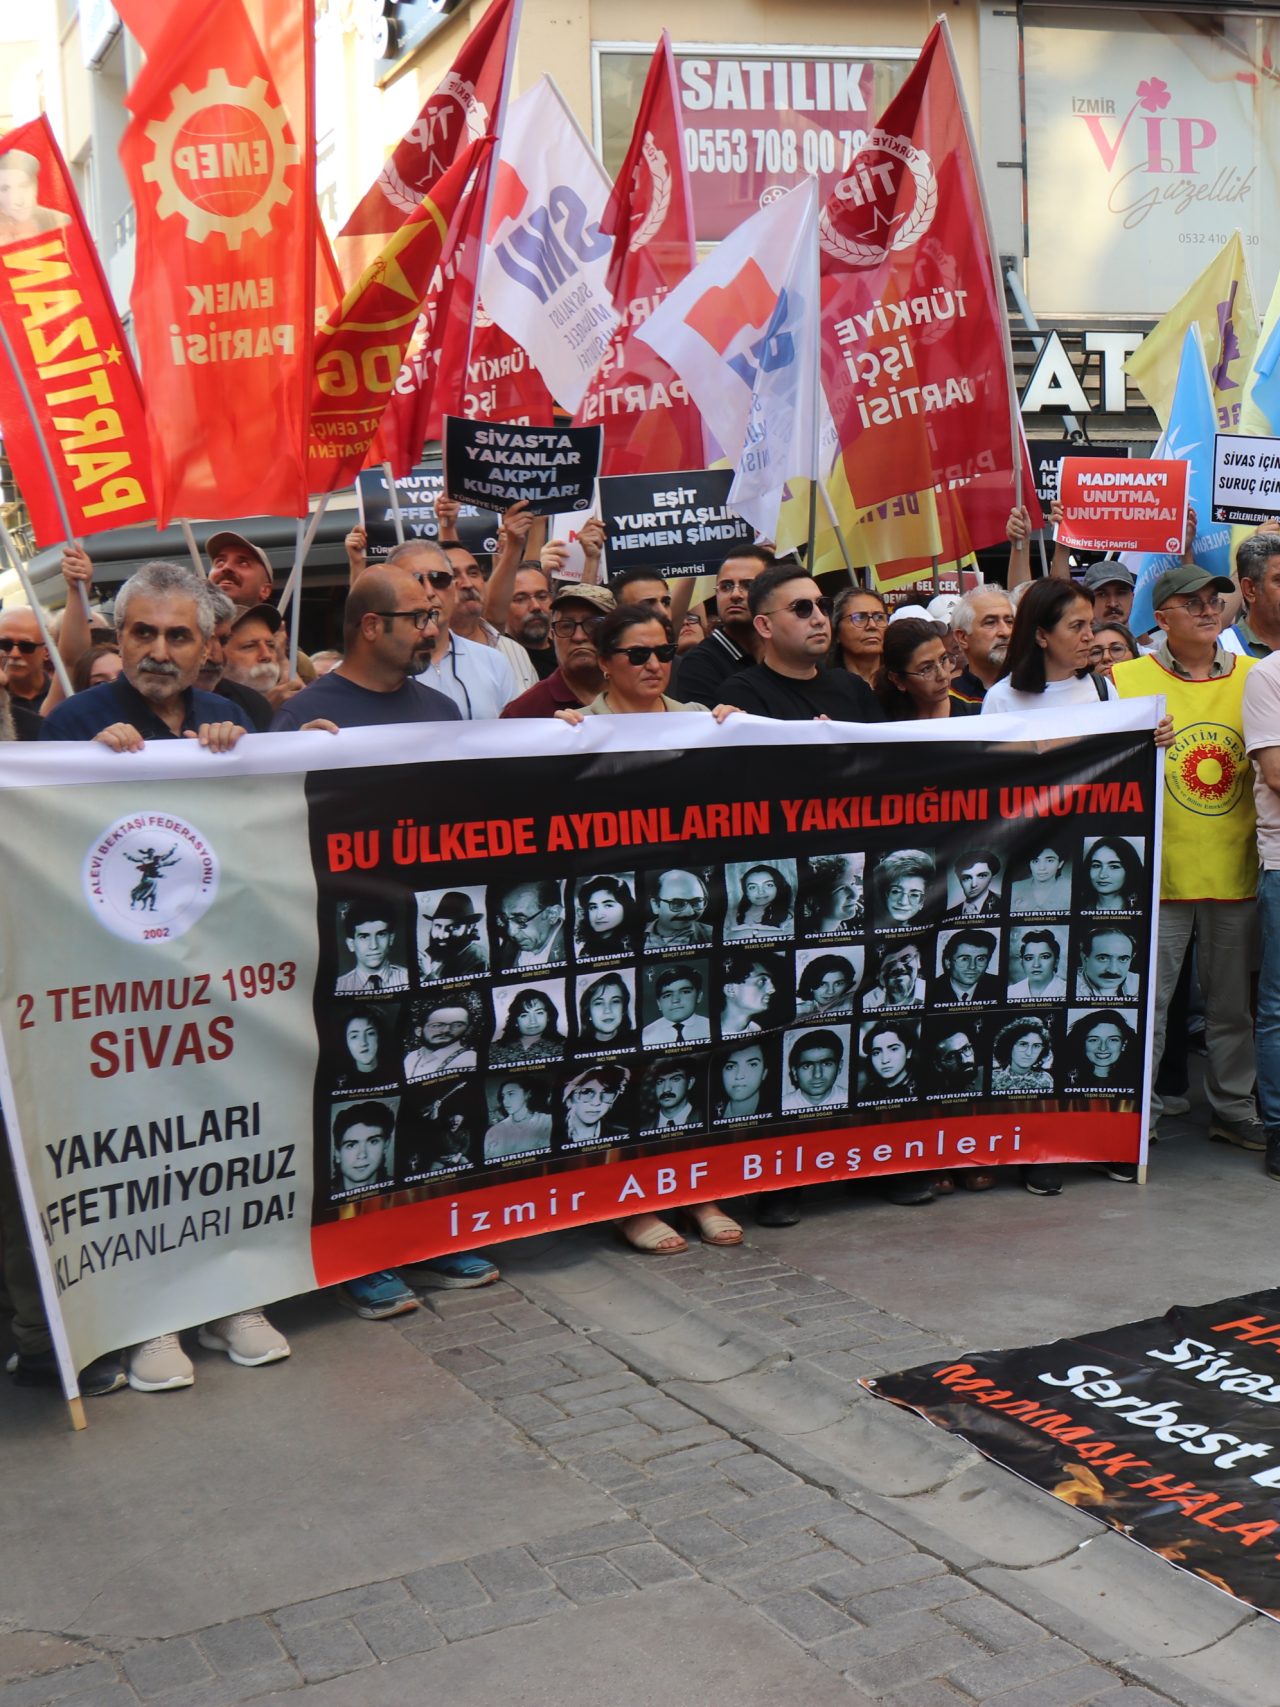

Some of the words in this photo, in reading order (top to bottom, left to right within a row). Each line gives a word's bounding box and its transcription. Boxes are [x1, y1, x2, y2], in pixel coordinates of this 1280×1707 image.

[681, 61, 867, 112] SATILIK
[1072, 96, 1115, 113] İZMİR
[1072, 110, 1217, 173] VIP
[685, 128, 747, 174] 0553
[752, 128, 797, 174] 708
[803, 129, 835, 174] 00
[1107, 158, 1257, 230] Güzellik
[1179, 233, 1205, 243] 0532
[474, 429, 572, 449] SİVAS'TA
[465, 446, 581, 466] YAKANLAR
[1223, 452, 1256, 469] SİVAS
[488, 467, 557, 483] AKP'Yİ
[1077, 473, 1168, 487] MADIMAK'I
[464, 478, 580, 501] KURANLAR!
[1218, 476, 1256, 494] SURUÇ
[653, 487, 697, 508] EŞİT
[1083, 490, 1160, 506] UNUTMA,
[1066, 506, 1177, 521] UNUTTURMA!
[611, 528, 683, 551] HEMEN
[686, 520, 747, 546] ŞİMDİ!
[1061, 535, 1093, 549] TÜRKİYE
[327, 829, 380, 872] BU
[392, 817, 537, 867] ÜLKEDE
[547, 800, 770, 852] AYDINLARIN
[781, 786, 988, 832] YAKILDIĞINI
[999, 781, 1144, 820] UNUTMA
[143, 928, 170, 940] 2002
[723, 936, 795, 947] ONURUMUZ
[643, 942, 713, 956] ONURUMUZ
[501, 961, 568, 975] ONURUMUZ
[420, 971, 492, 988] ONURUMUZ
[17, 994, 36, 1030] 2
[46, 973, 212, 1022] TEMMUZ
[222, 961, 297, 1001] 1993
[1006, 997, 1067, 1005] ONURUMUZ
[862, 1004, 925, 1015] ONURUMUZ
[643, 1038, 712, 1051] ONURUMUZ
[488, 1056, 564, 1070] ONURUMUZ
[991, 1088, 1054, 1096] ONURUMUZ
[781, 1103, 849, 1117] ONURUMUZ
[46, 1102, 260, 1179] YAKANLARI
[483, 1148, 552, 1166] ONURUMUZ
[618, 1161, 709, 1202] ABF
[743, 1126, 1022, 1181] Bileşenleri
[243, 1191, 295, 1230] DA!
[932, 1363, 1152, 1477] MADIMAK
[1038, 1364, 1274, 1468] Serbest
